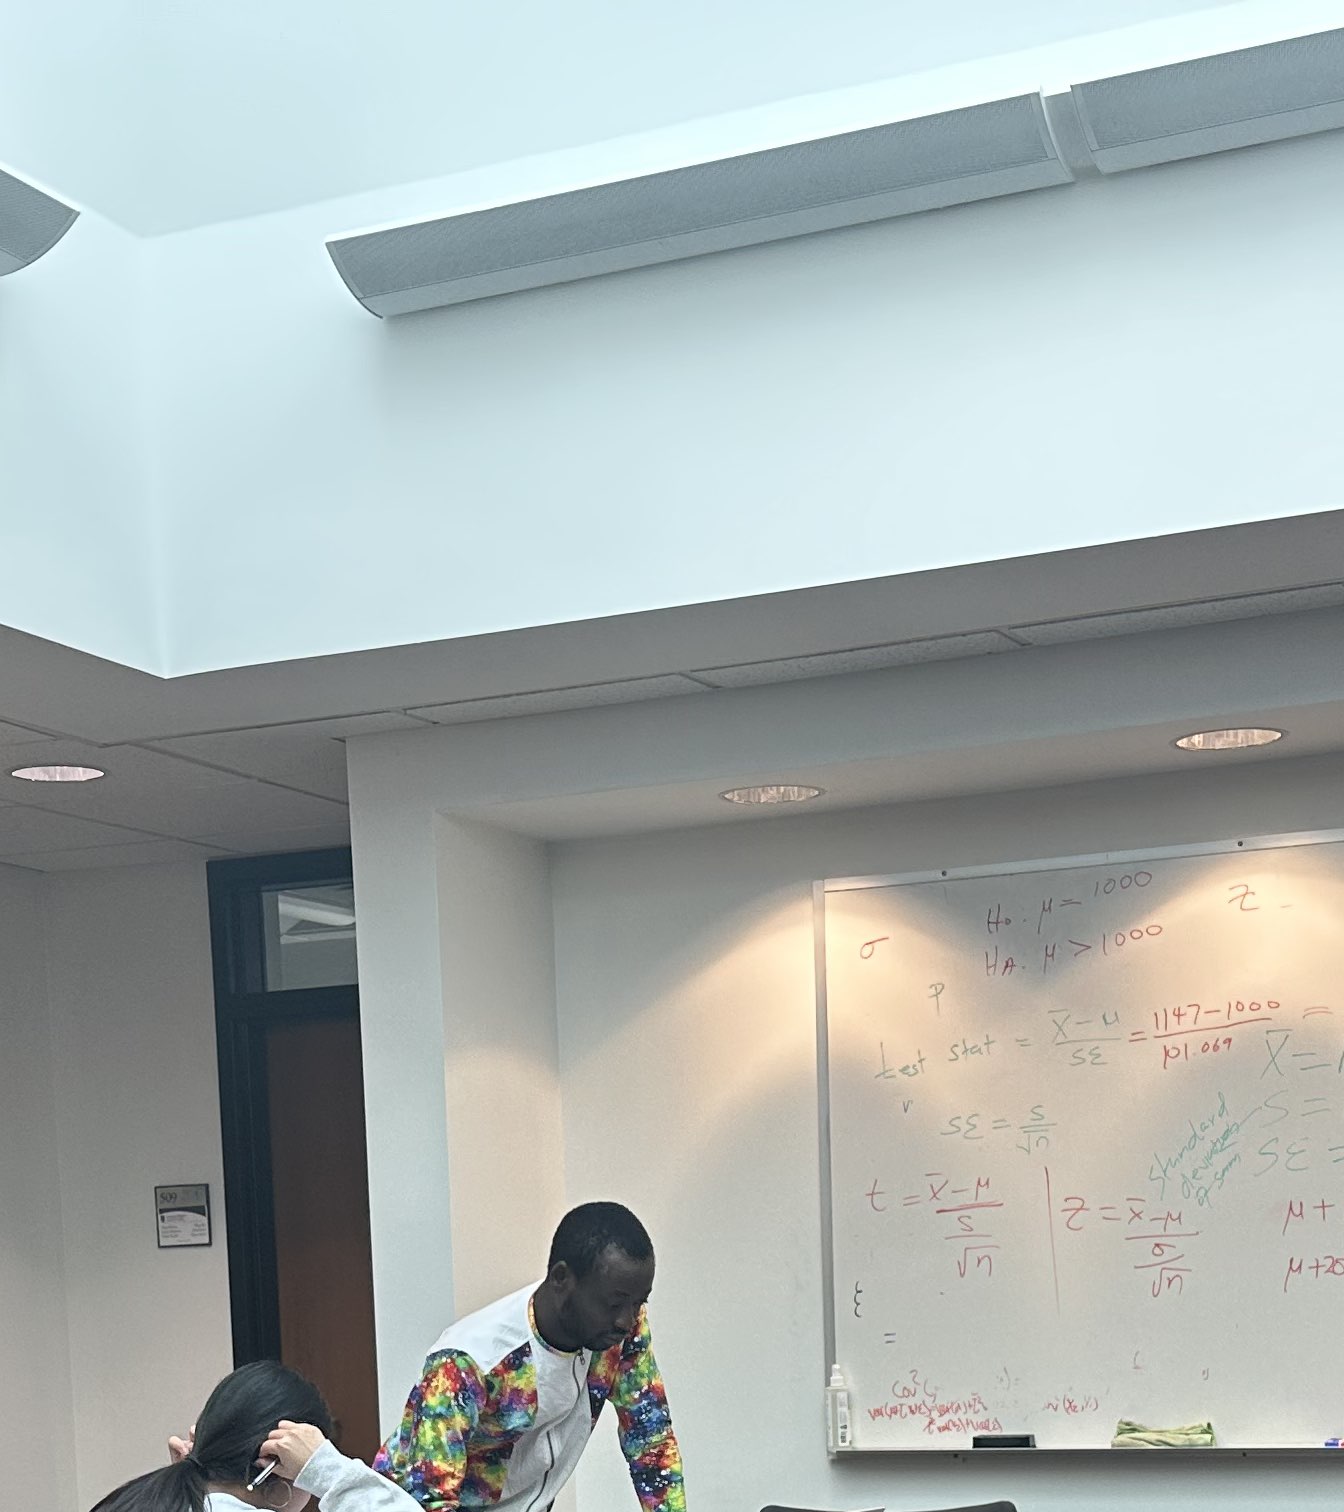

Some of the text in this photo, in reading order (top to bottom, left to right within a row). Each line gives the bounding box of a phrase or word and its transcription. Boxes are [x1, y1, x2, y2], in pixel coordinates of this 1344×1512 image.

[1093, 871, 1153, 897] 1000
[1102, 925, 1163, 956] 1000
[874, 1041, 926, 1079] test
